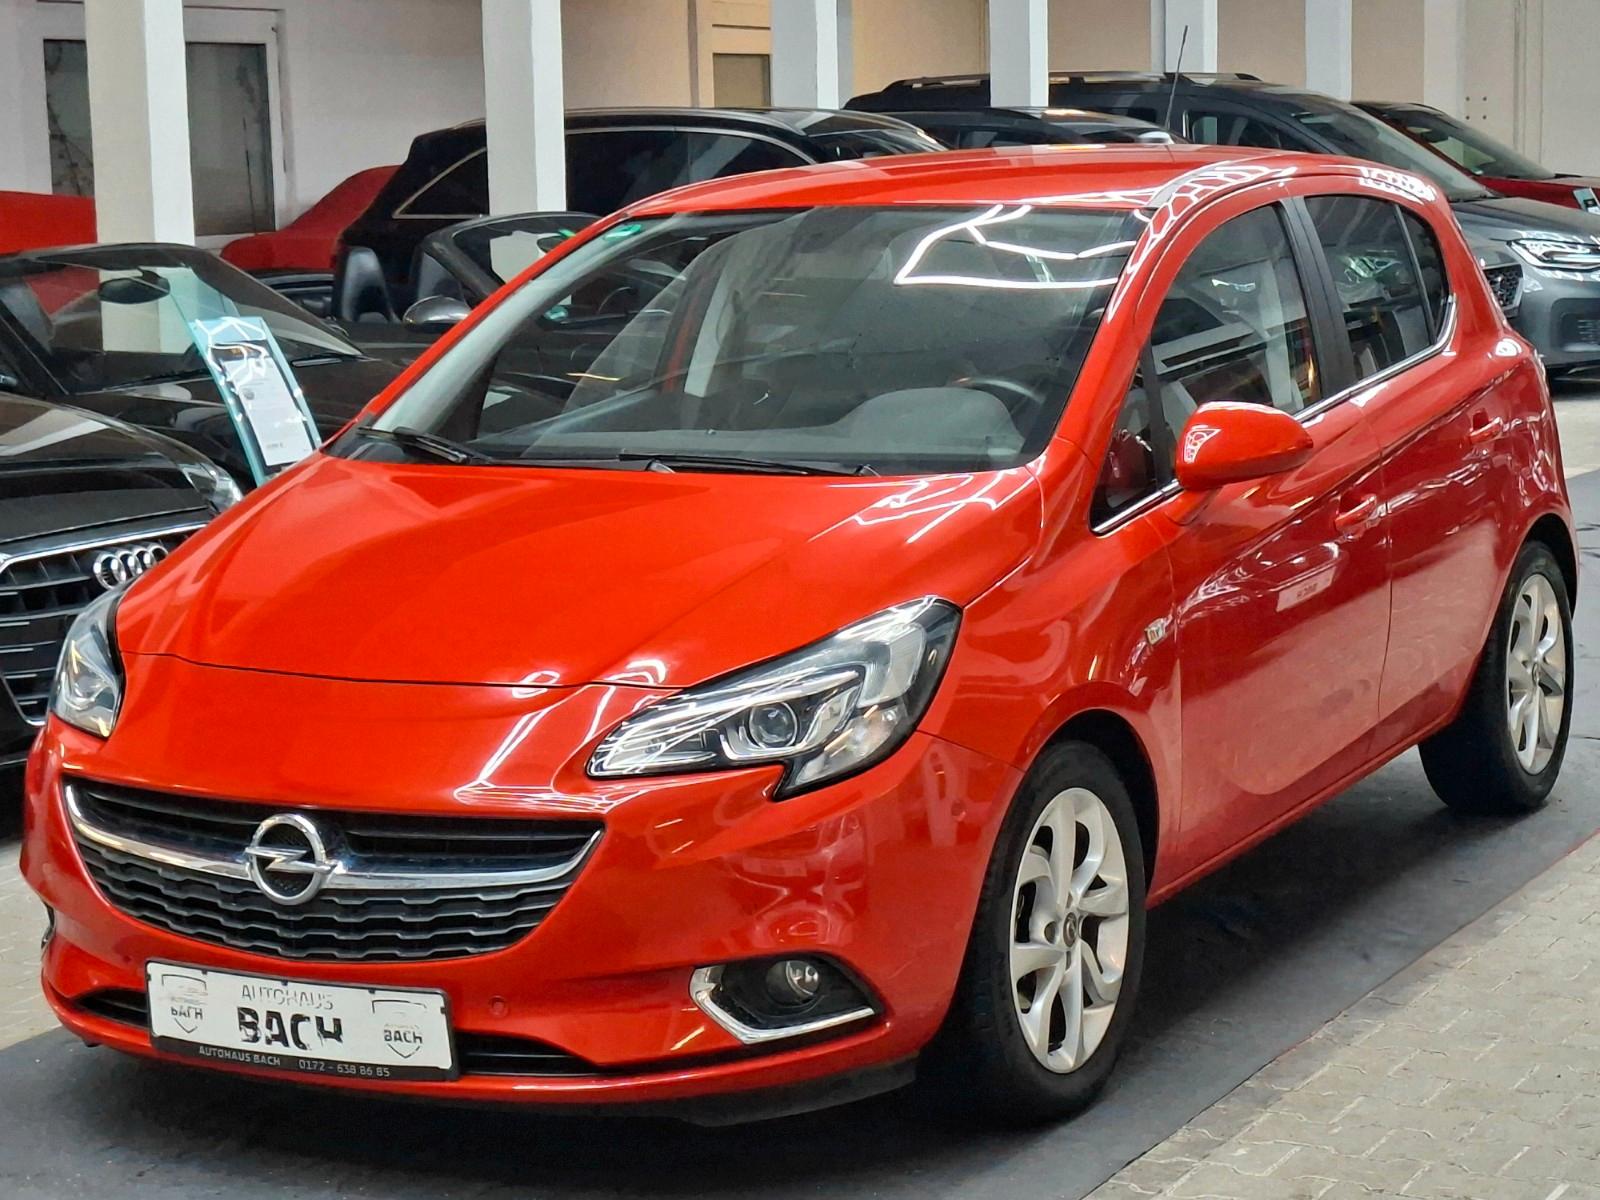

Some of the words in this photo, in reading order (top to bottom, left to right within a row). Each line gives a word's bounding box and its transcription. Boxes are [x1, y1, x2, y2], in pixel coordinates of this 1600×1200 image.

[242, 985, 333, 1010] AUTOHAUS
[237, 1006, 343, 1050] BACH
[199, 1045, 251, 1062] AUTOHAUS
[253, 1054, 281, 1066] BACH
[299, 1059, 325, 1071] 0172
